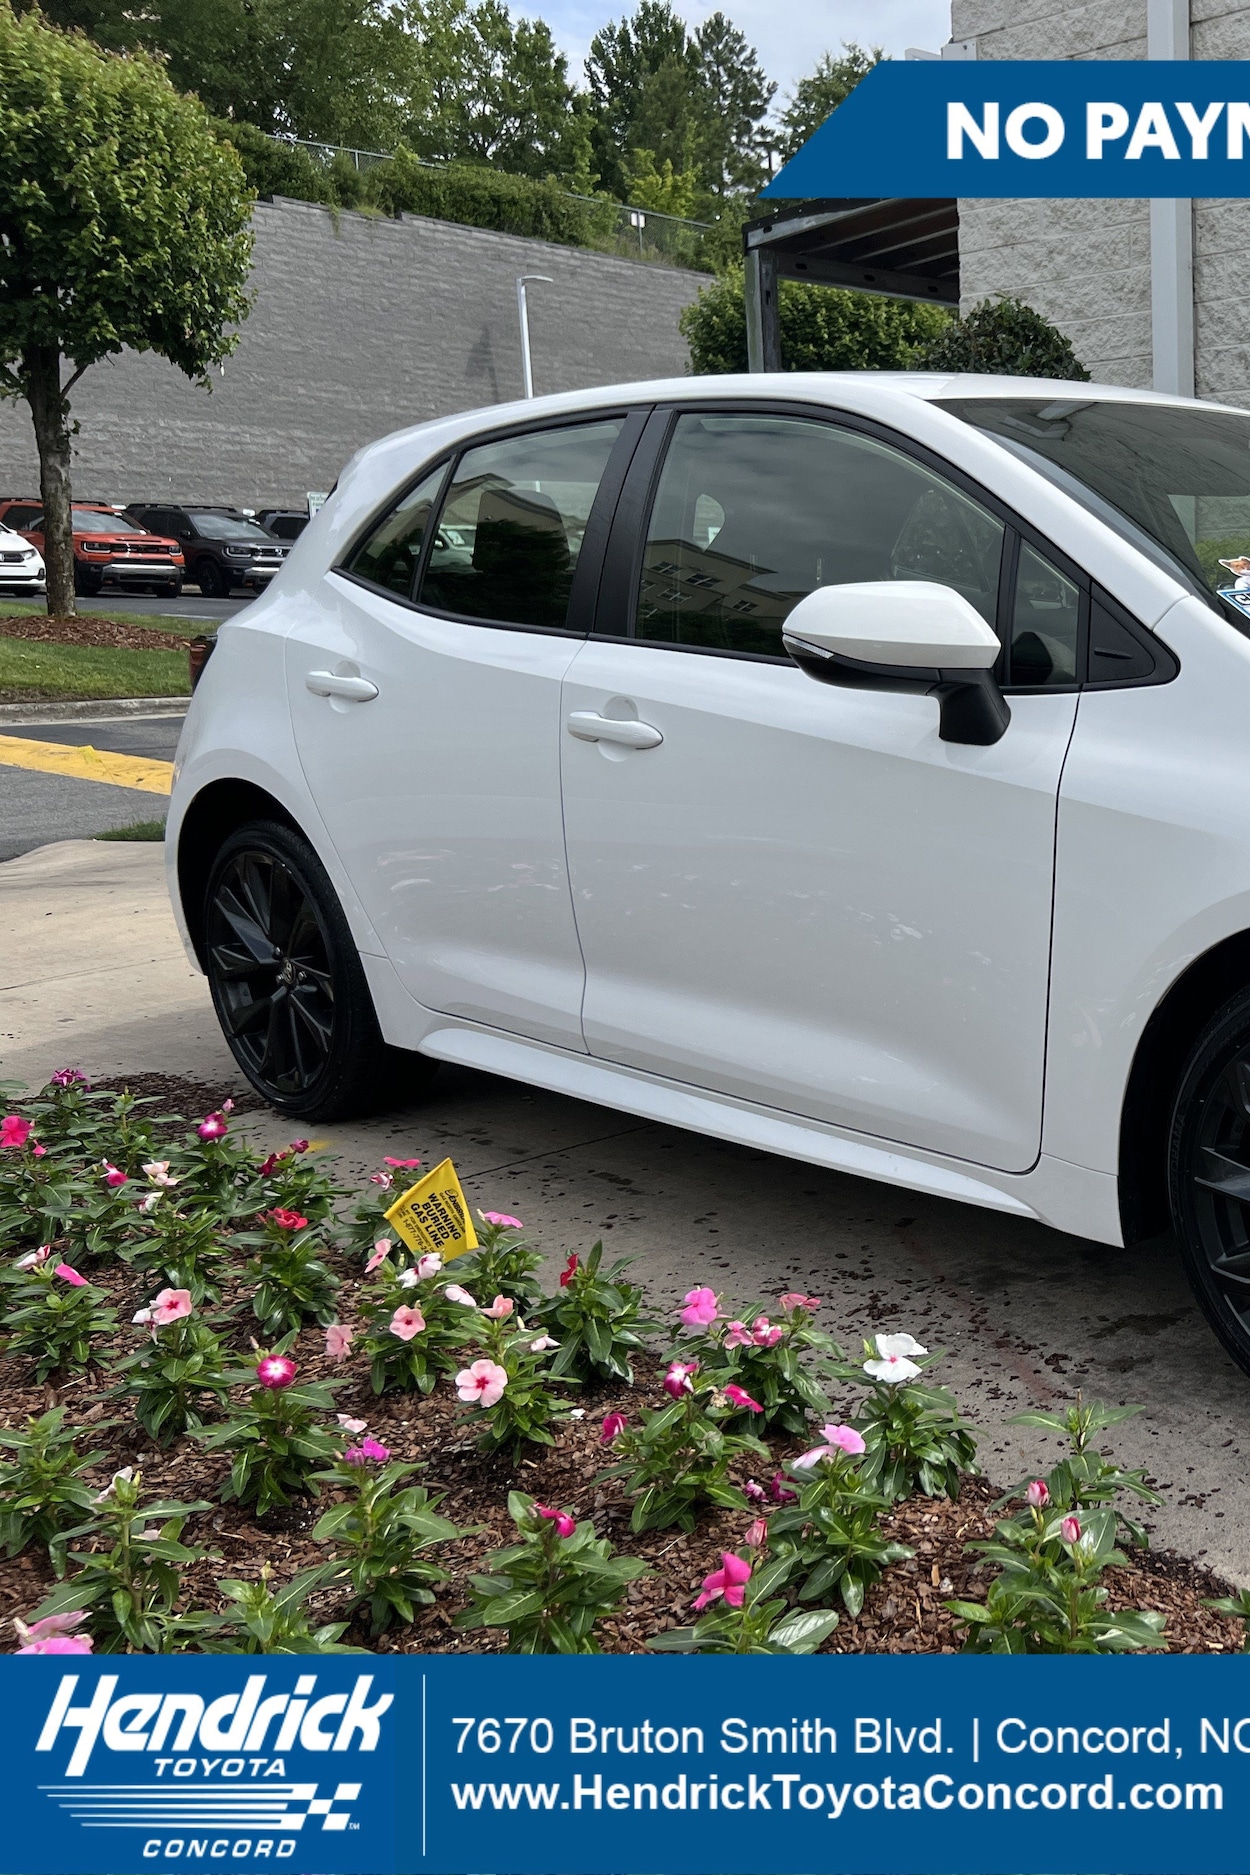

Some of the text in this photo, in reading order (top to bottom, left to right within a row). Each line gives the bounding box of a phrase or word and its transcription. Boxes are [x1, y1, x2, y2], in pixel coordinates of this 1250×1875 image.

[410, 1202, 445, 1248] GAS LINE
[422, 1202, 450, 1240] BURIED
[427, 1192, 462, 1241] WARNING
